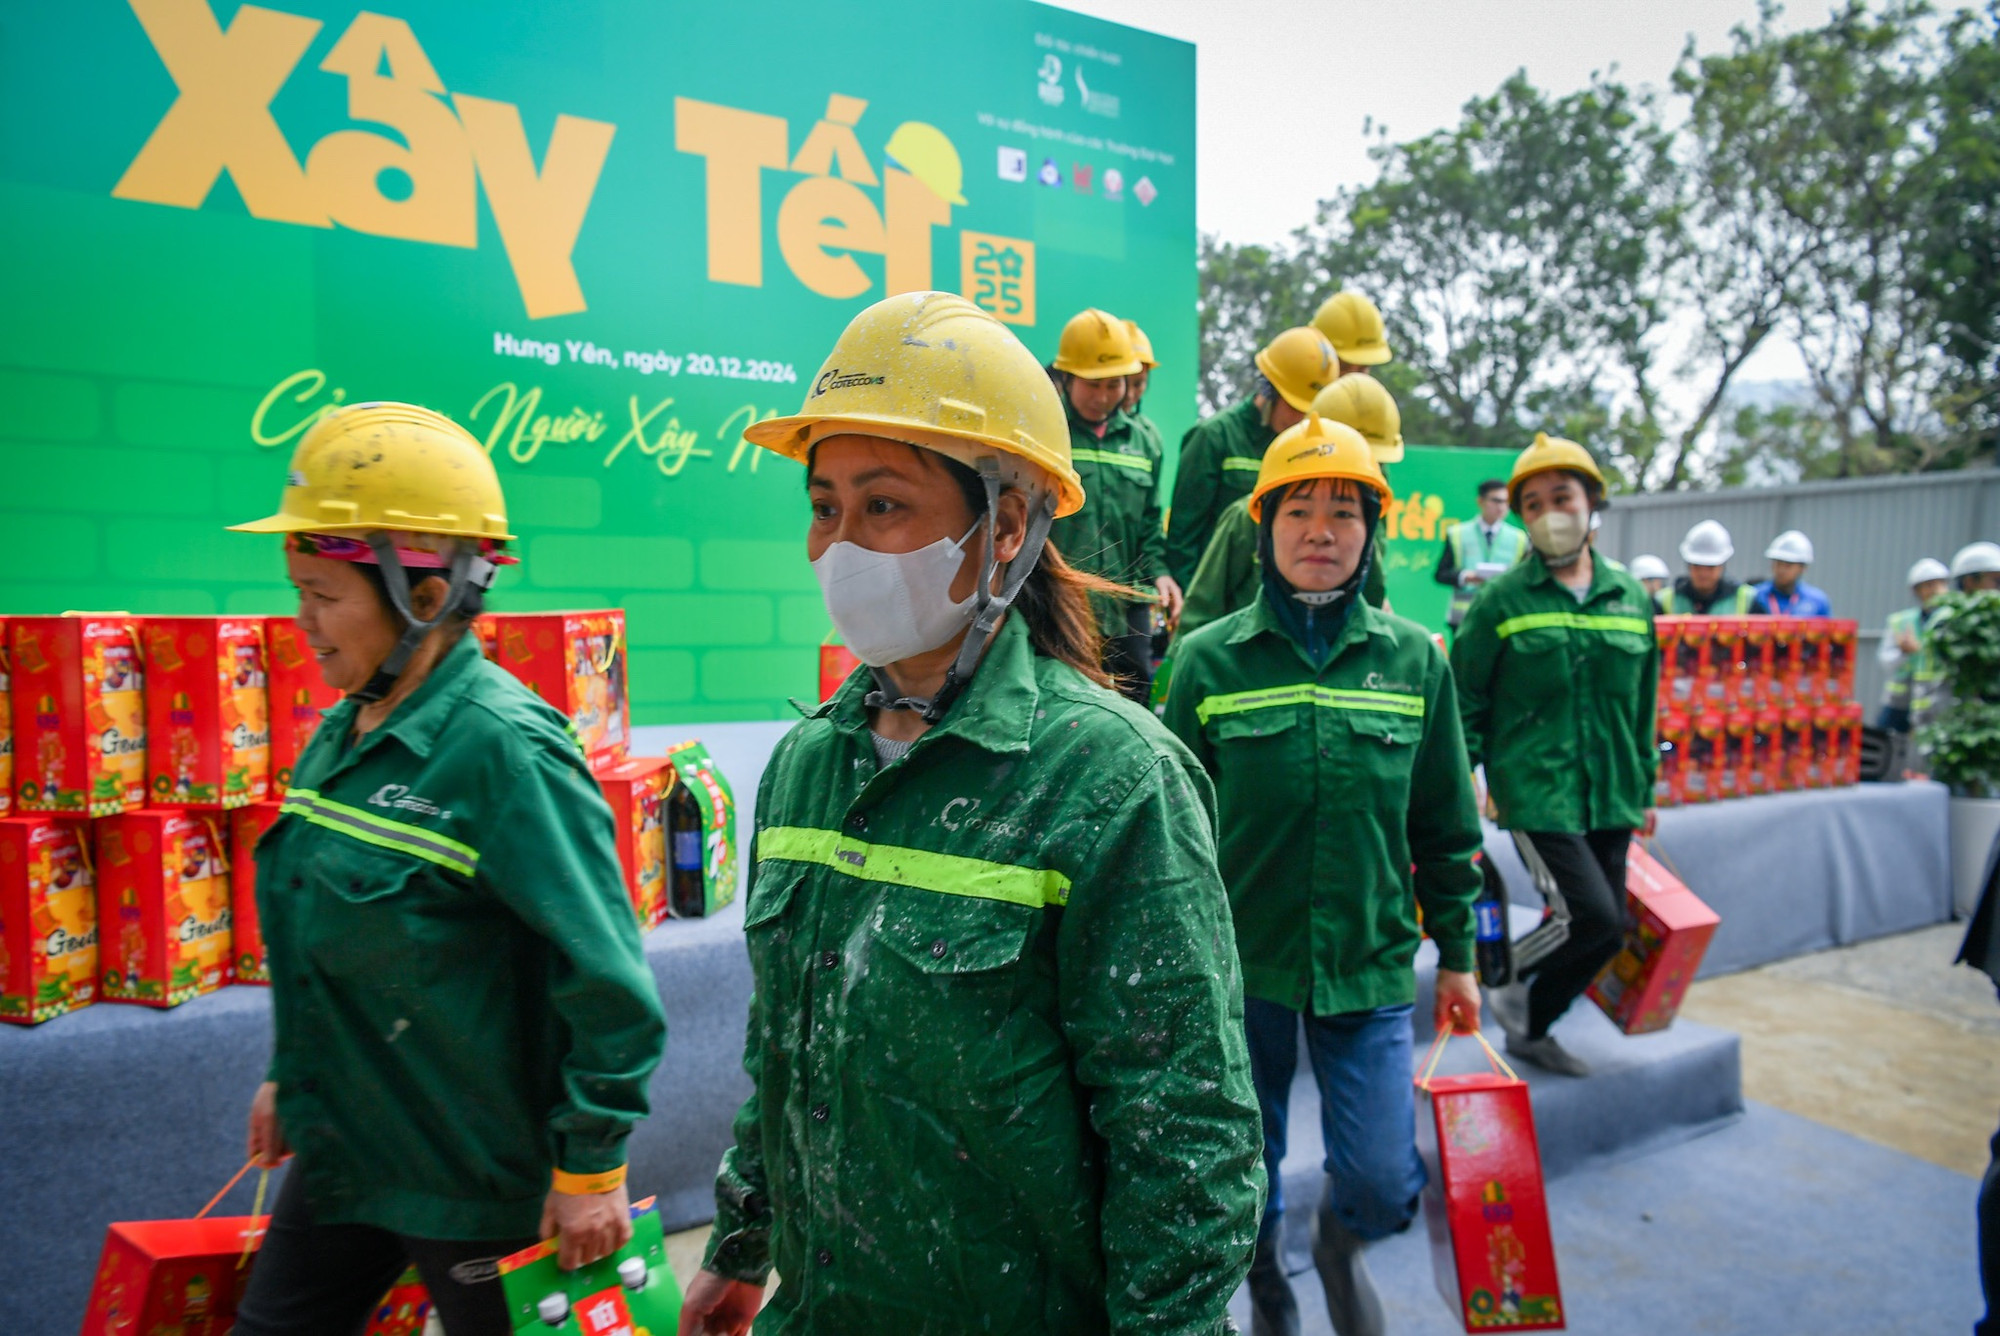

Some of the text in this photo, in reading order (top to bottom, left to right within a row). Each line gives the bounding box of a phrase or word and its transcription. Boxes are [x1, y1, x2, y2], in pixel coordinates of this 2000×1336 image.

[493, 332, 797, 384] Hưng Yên, ngày 20.12.2024
[470, 381, 607, 464] Người
[604, 395, 713, 476] Xây
